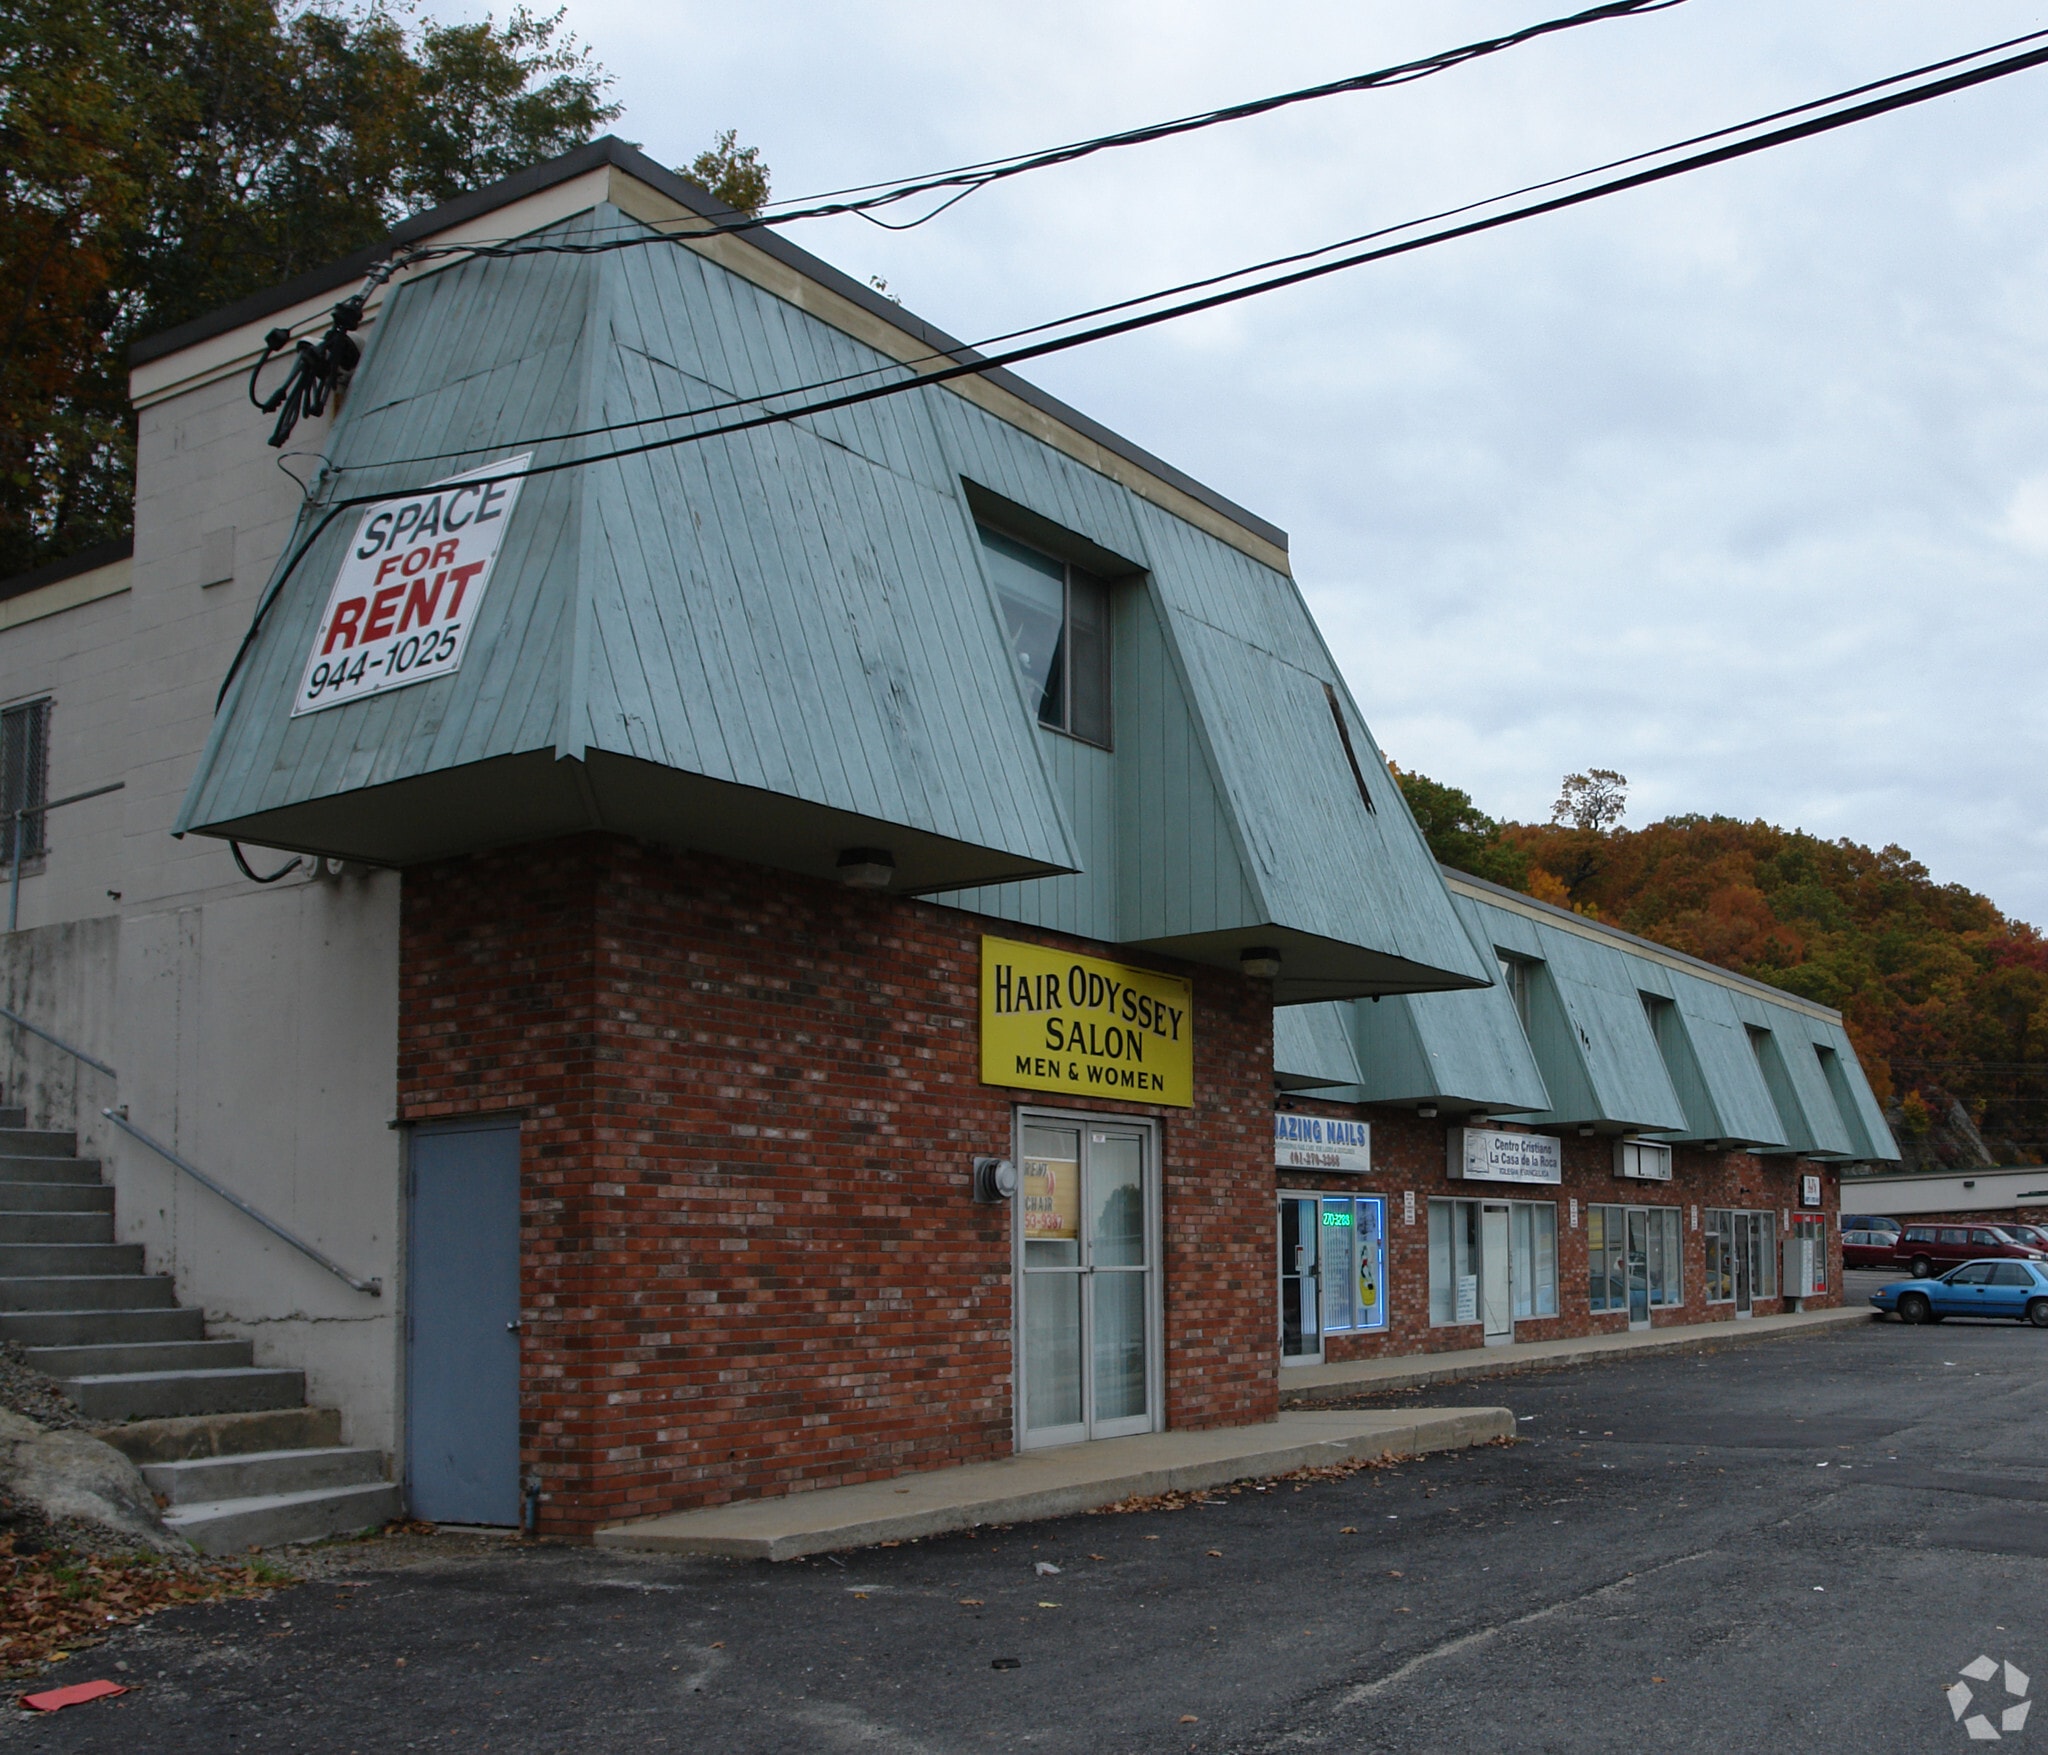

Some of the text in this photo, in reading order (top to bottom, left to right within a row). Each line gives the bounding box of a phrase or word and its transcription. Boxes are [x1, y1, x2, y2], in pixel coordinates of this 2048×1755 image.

[356, 483, 507, 560] SPACE
[373, 538, 460, 586] FOR
[320, 559, 486, 656] RENT
[307, 623, 461, 699] 944-1025
[994, 964, 1184, 1041] HAIR ODYSSEY
[1045, 1017, 1143, 1063] SALON
[1015, 1055, 1164, 1091] MEN & WOMEN
[1326, 1121, 1366, 1147] NAILS
[1494, 1138, 1552, 1154] Centro Cristiano
[1024, 1162, 1048, 1177] RENT
[1490, 1152, 1557, 1168] La Casa de la Roca
[1025, 1196, 1053, 1212] CHAIR
